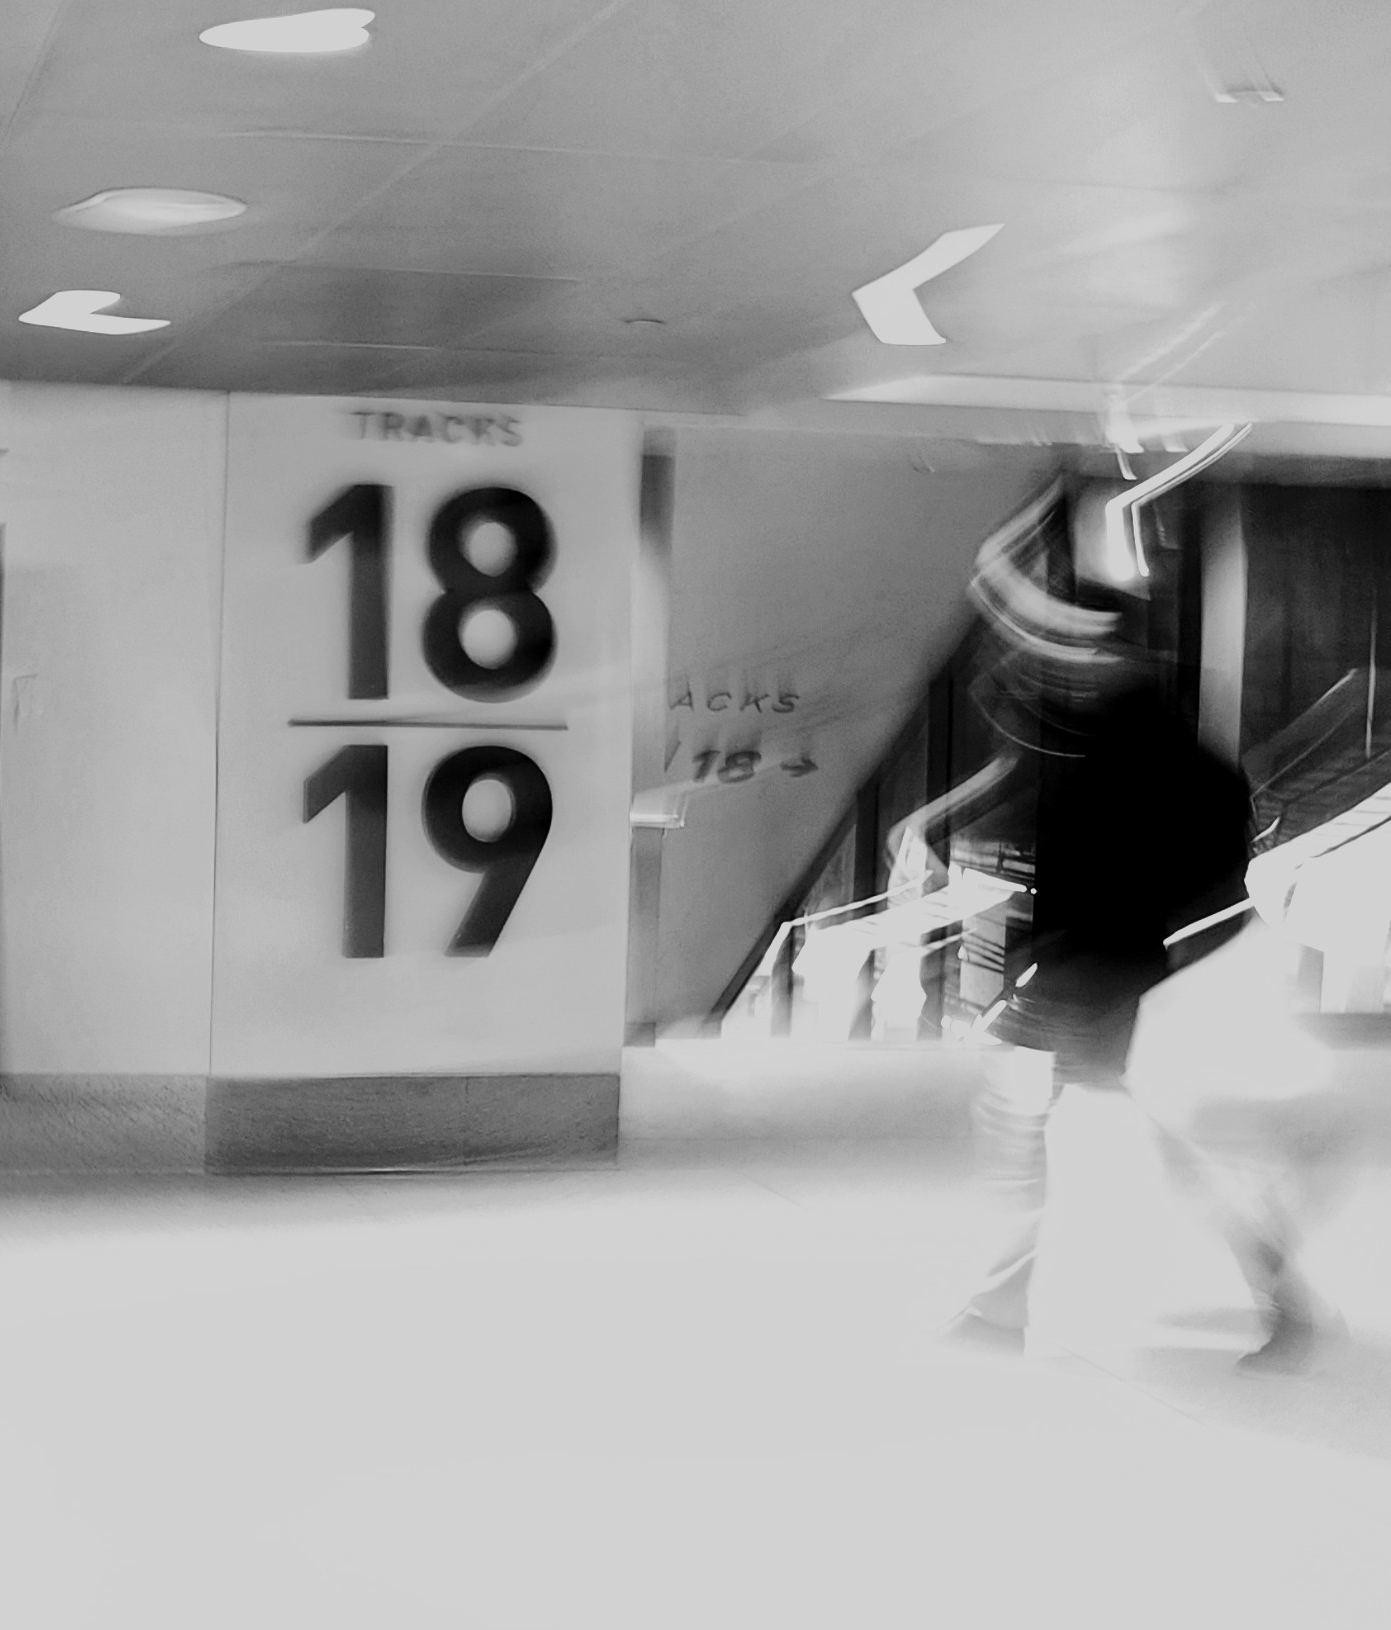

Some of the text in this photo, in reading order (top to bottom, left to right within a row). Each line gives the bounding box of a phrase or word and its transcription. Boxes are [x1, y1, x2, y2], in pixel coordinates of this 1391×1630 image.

[351, 411, 524, 447] TRACKS
[303, 484, 559, 704] 18
[302, 744, 553, 959] 19
